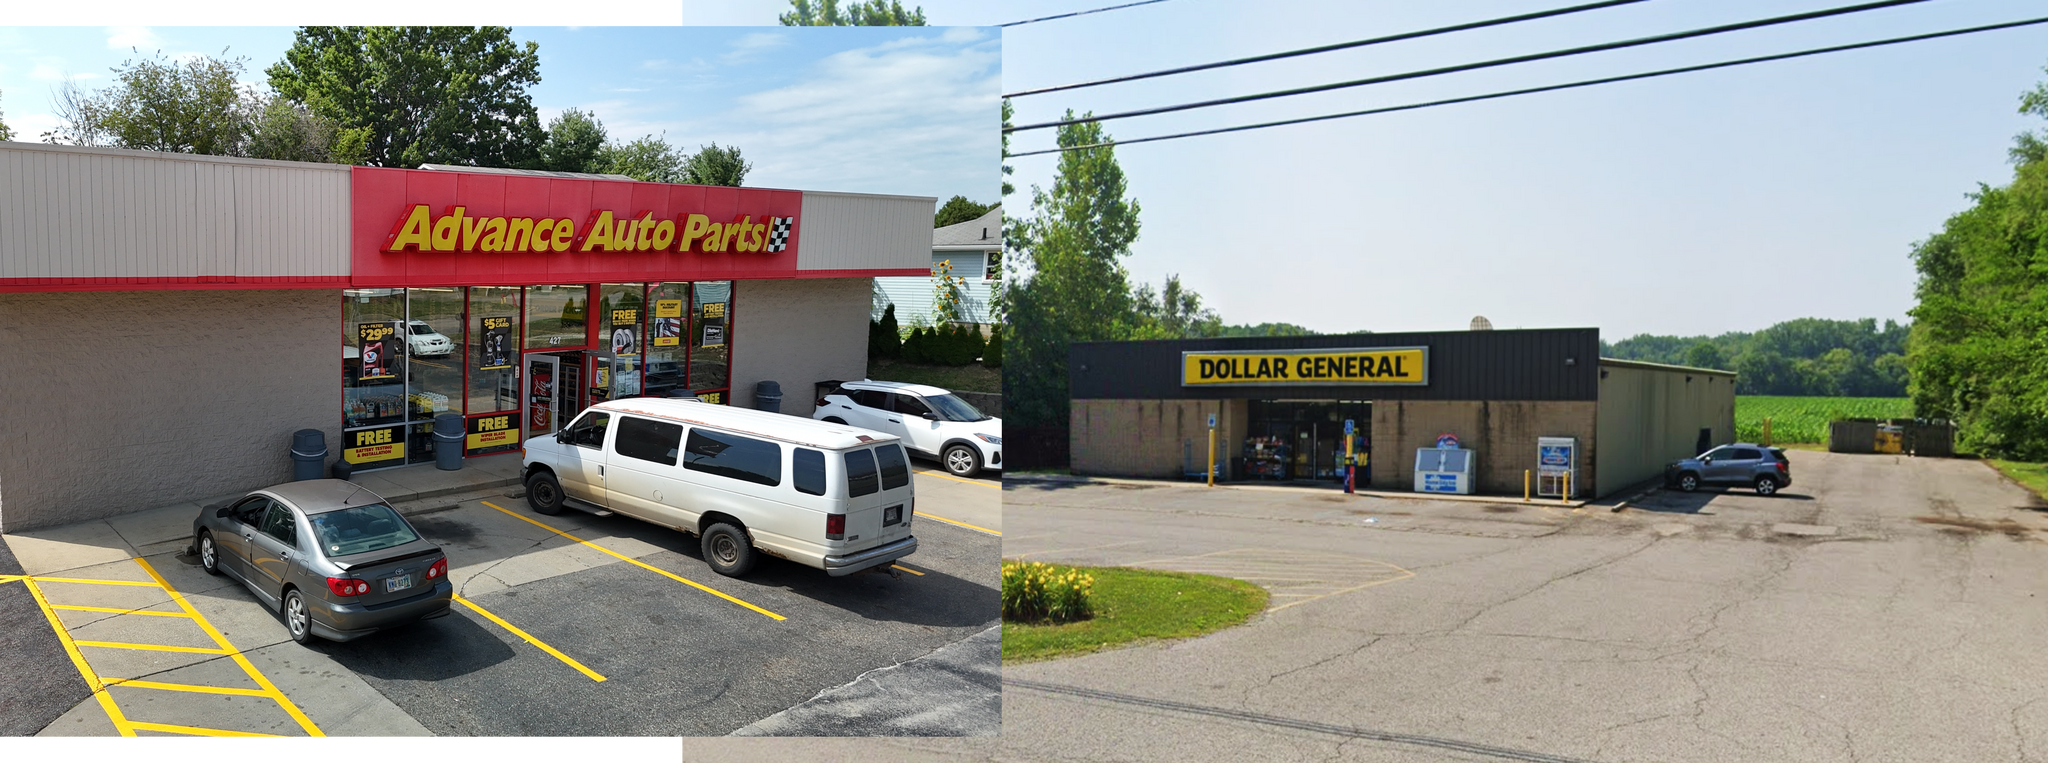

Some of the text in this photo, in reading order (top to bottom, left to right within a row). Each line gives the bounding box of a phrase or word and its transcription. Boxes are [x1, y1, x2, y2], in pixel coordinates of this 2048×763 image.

[388, 204, 763, 253] Advance Auto Parts
[612, 309, 637, 320] FREE
[703, 303, 725, 313] FREE
[484, 318, 496, 330] $5
[549, 336, 562, 345] 427
[1199, 355, 1409, 380] DOLLAR GENERAL
[478, 416, 509, 432] FREE
[357, 429, 392, 446] FREE
